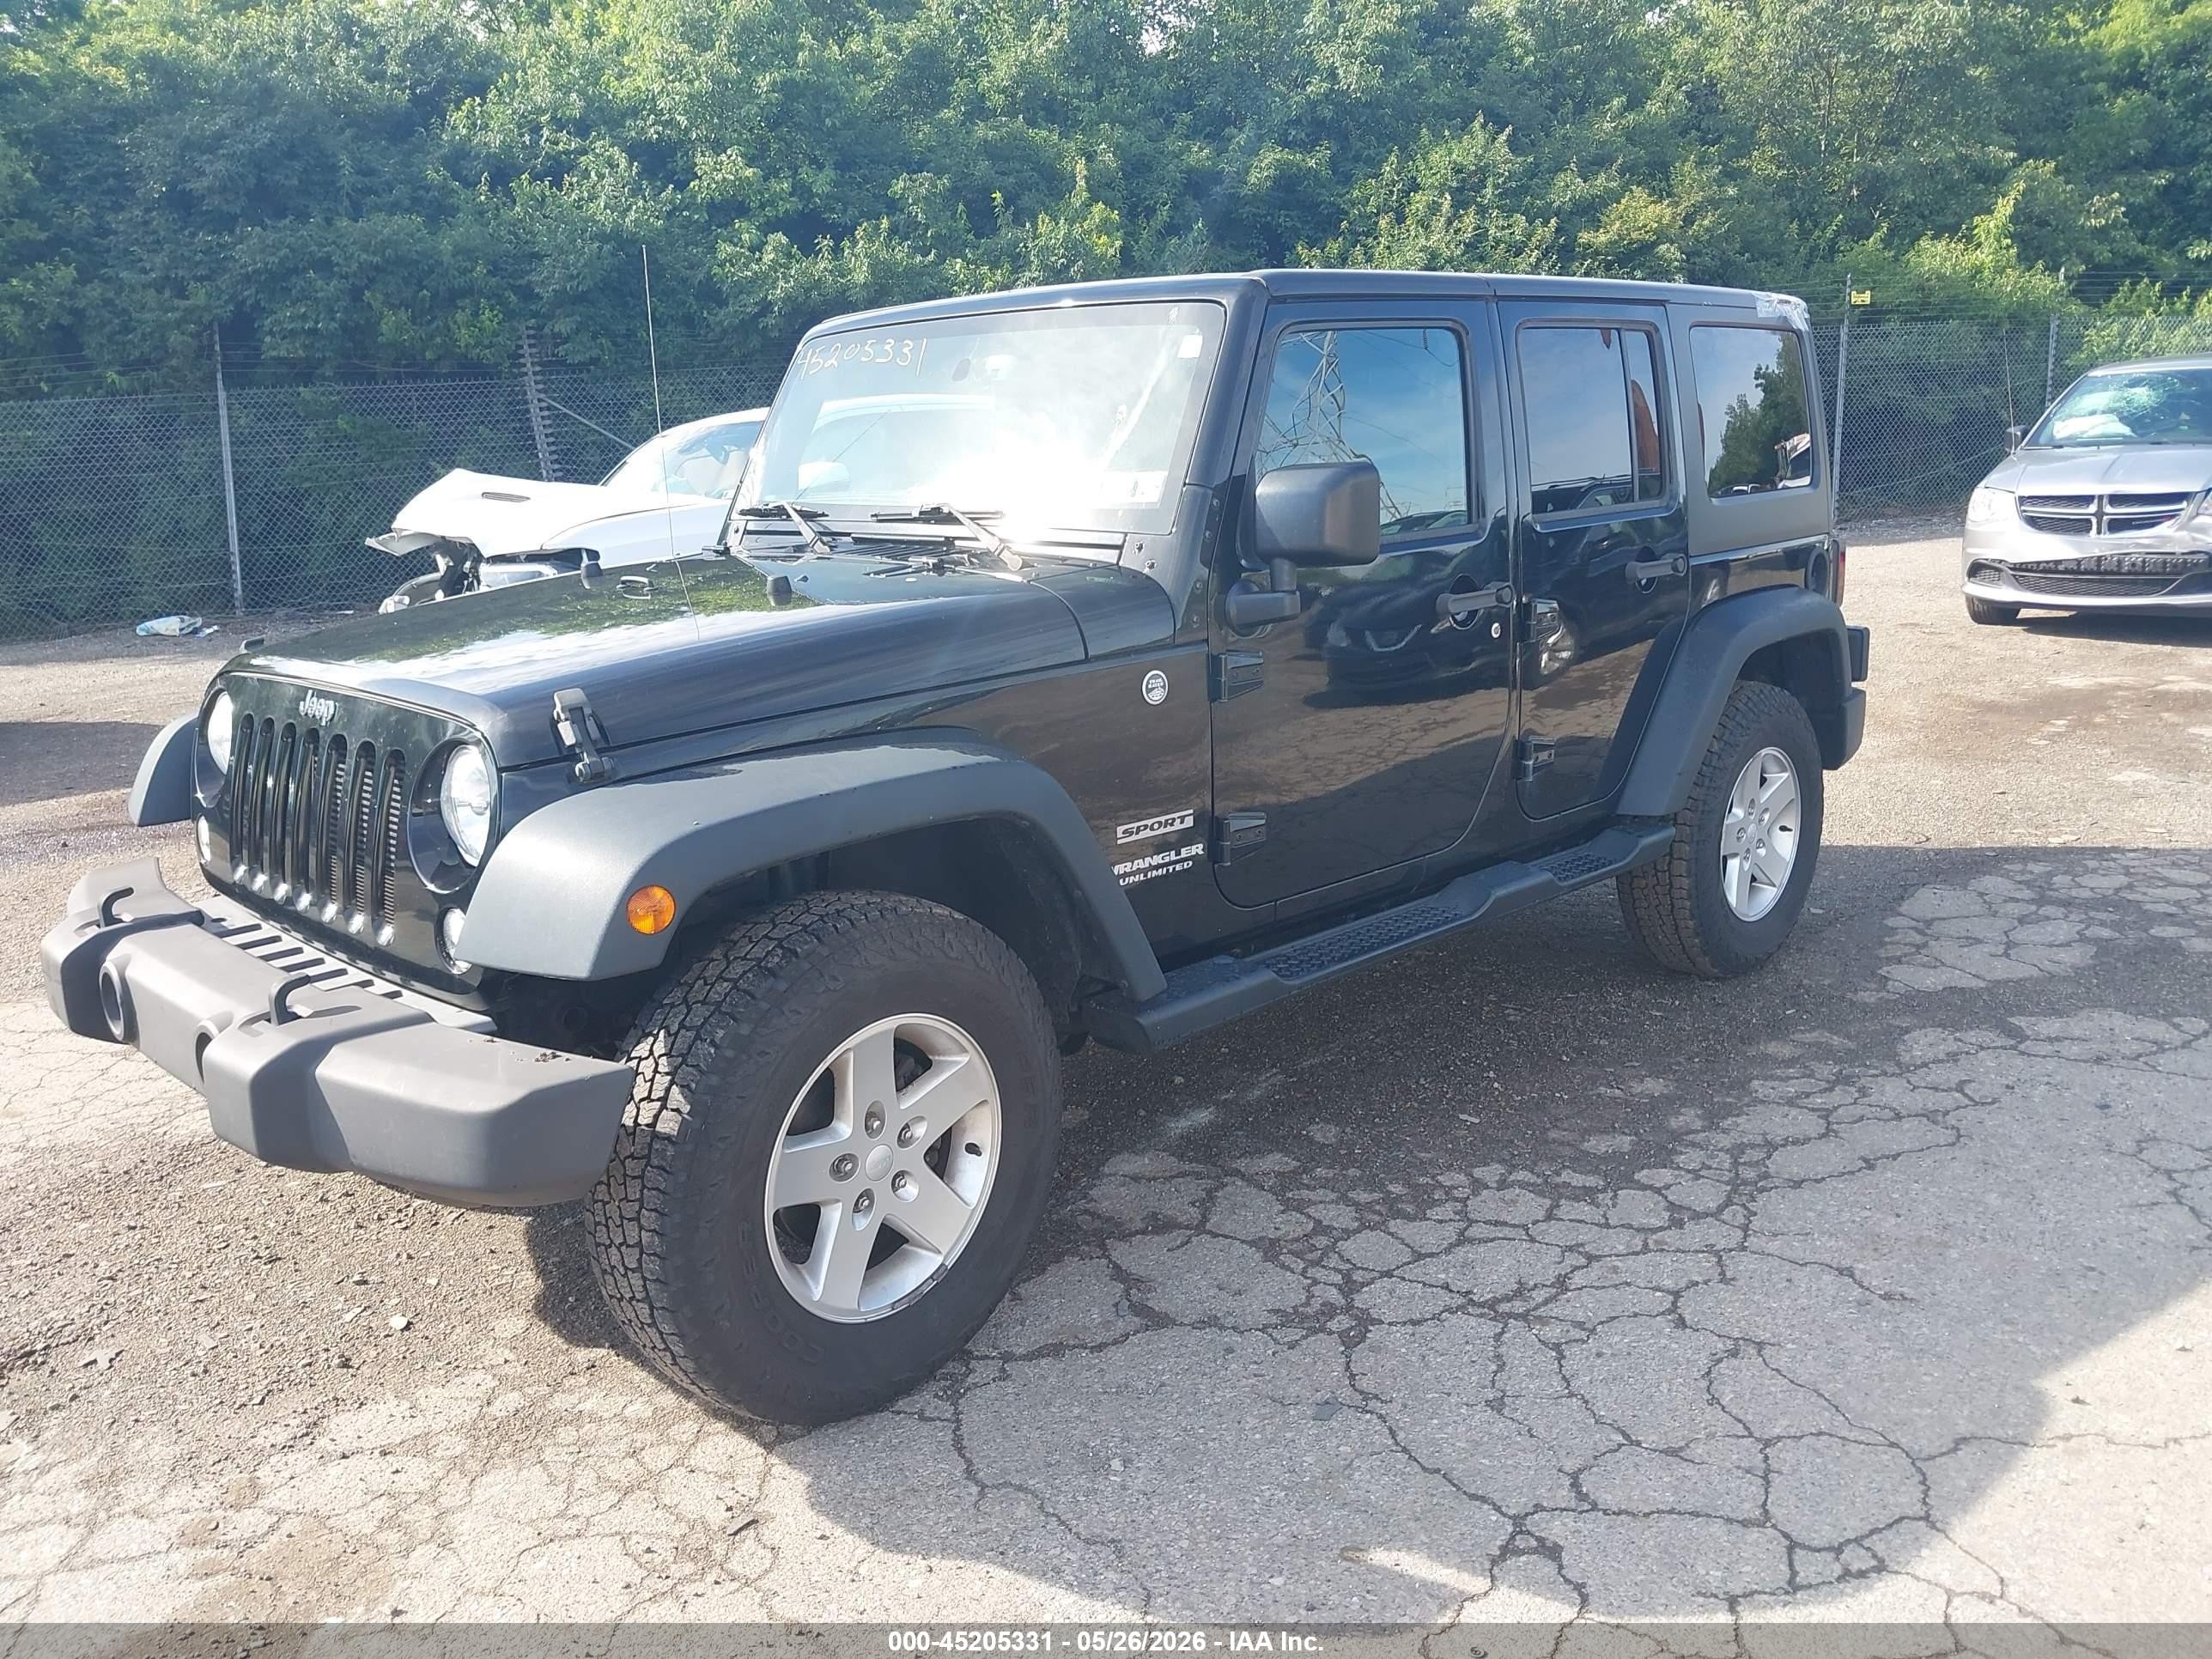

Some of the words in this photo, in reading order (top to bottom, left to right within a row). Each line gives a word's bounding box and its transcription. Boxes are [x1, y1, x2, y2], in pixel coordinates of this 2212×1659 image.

[797, 337, 927, 380] 45205331
[299, 689, 336, 726] Jeep
[1118, 812, 1194, 840] SPORT
[1119, 860, 1193, 886] UNLIMITED
